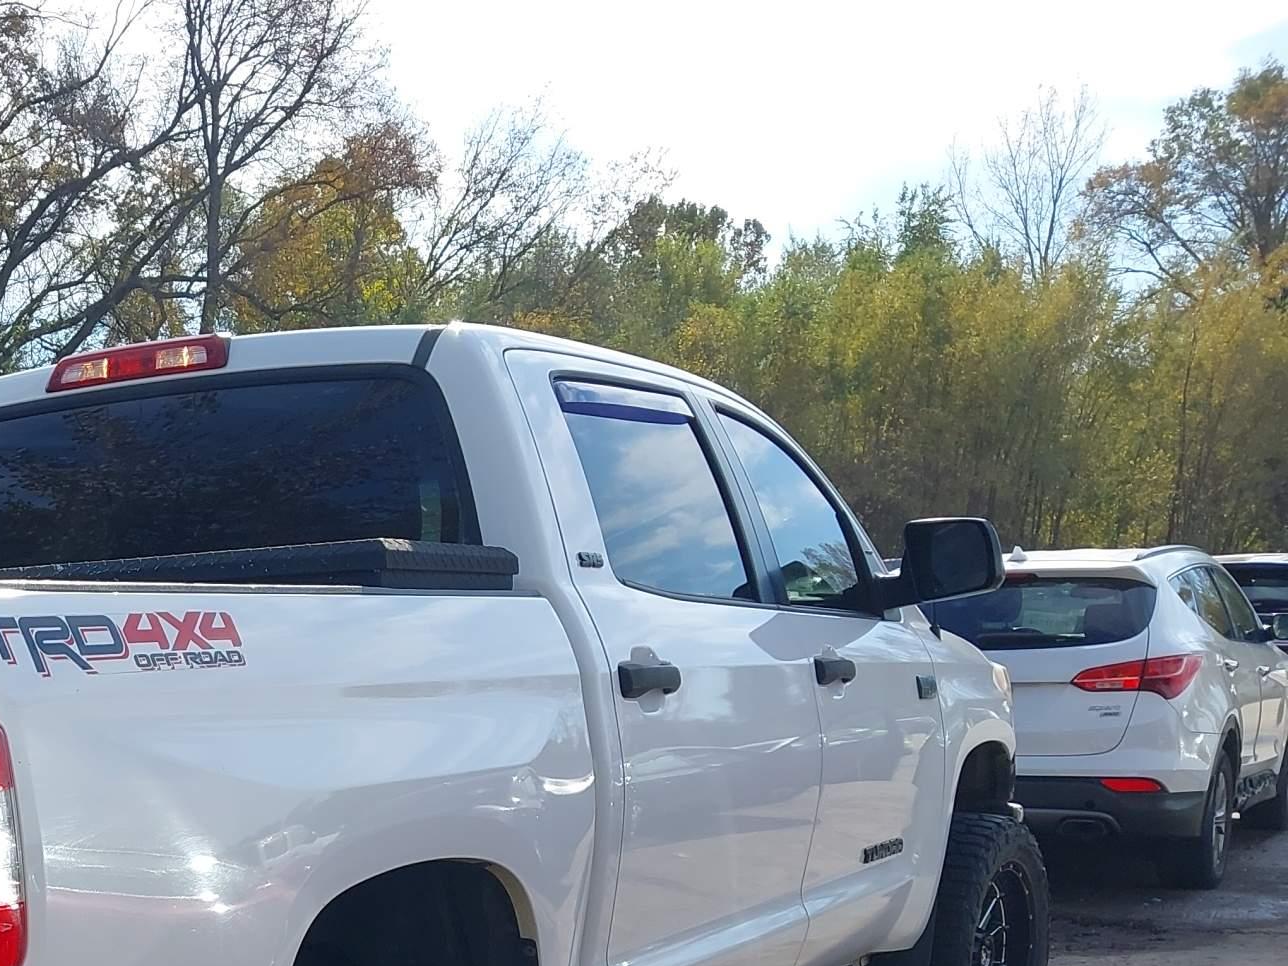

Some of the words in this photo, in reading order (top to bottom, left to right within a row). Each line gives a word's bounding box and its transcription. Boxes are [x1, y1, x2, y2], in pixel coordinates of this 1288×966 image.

[122, 611, 243, 651] 4X4
[133, 652, 182, 671] OFF
[183, 650, 247, 668] ROAD
